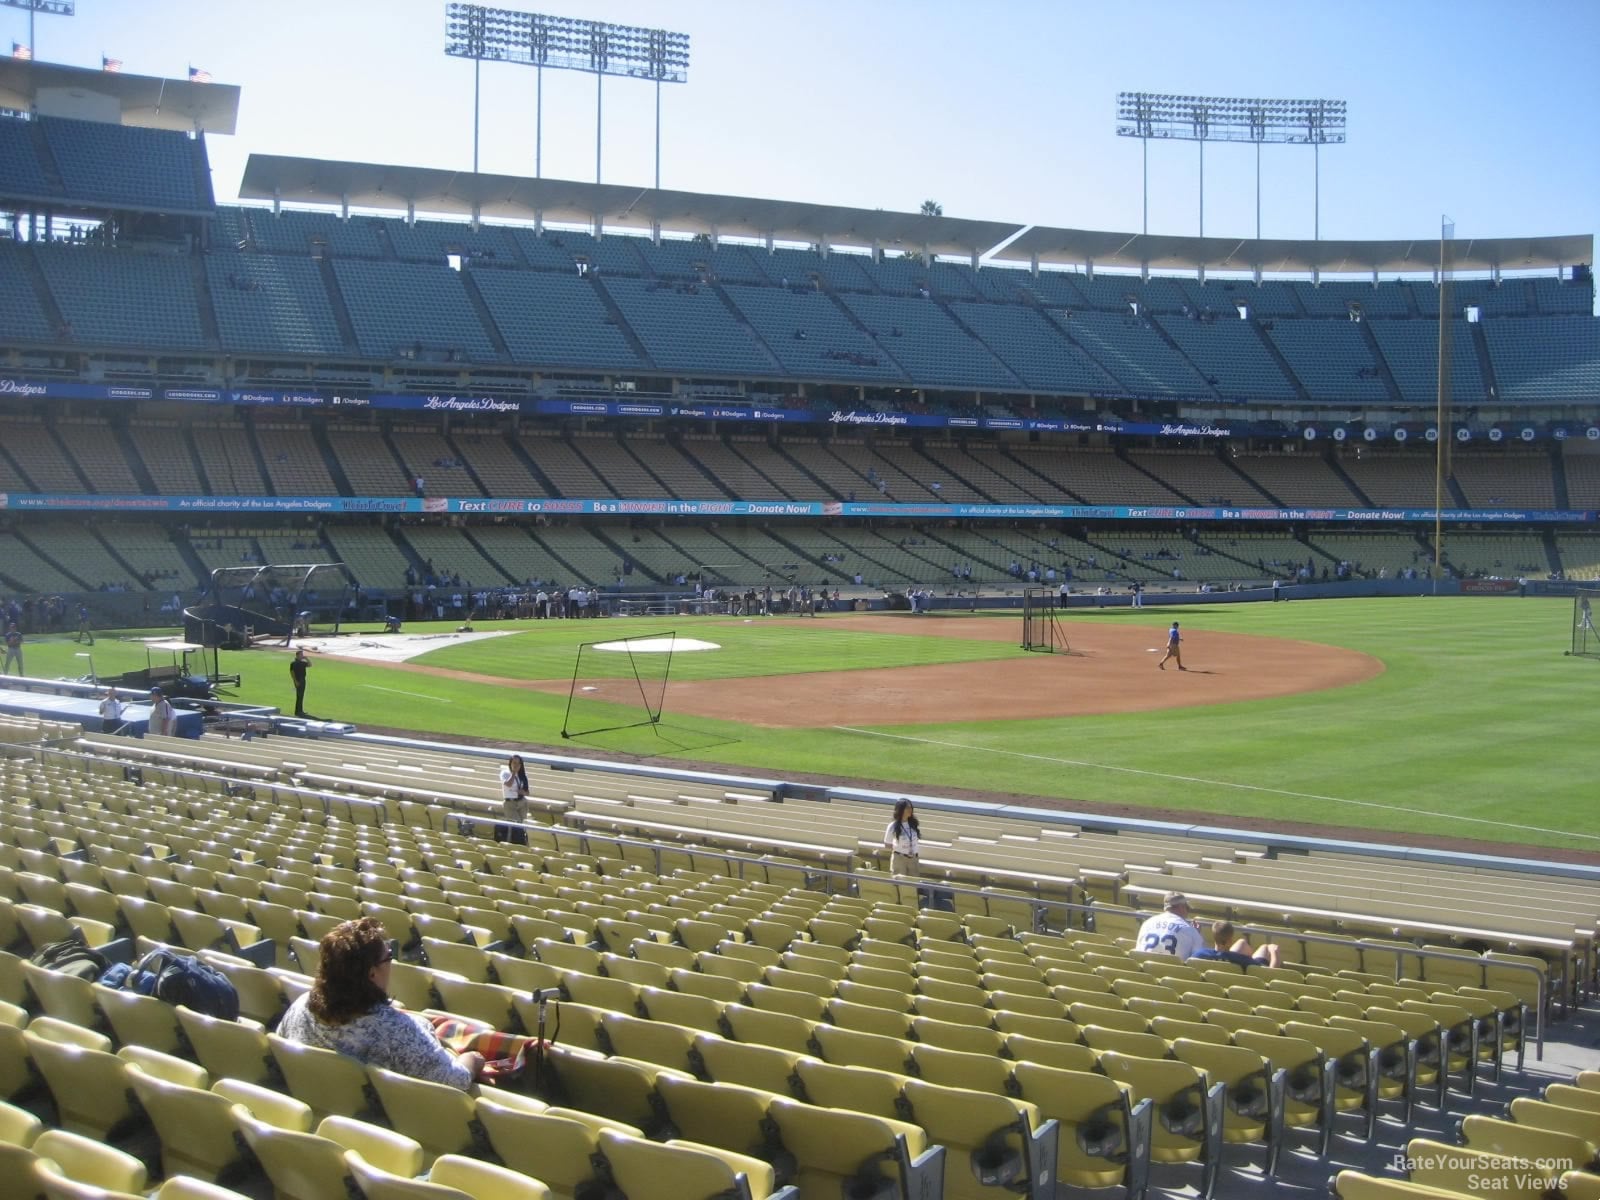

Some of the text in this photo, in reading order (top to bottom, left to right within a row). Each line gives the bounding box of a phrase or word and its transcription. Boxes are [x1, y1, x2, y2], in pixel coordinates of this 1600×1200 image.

[0, 380, 47, 396] Dodgers
[242, 394, 274, 402] @Dodgers
[292, 396, 323, 404] @Dodgers
[424, 396, 520, 411] Los Angeles Dodgers
[828, 411, 907, 424] Los Angeles Dodgers
[1160, 424, 1230, 437] Los Angeles Dodgers
[192, 499, 215, 507] official
[217, 500, 240, 508] charity
[275, 500, 302, 509] Angeles
[304, 500, 331, 510] Dodgers
[458, 500, 486, 511] Text
[527, 501, 541, 511] to
[593, 502, 608, 511] Be
[667, 503, 679, 512] in
[680, 503, 697, 512] the
[748, 504, 786, 513] Donate
[786, 504, 811, 513] Now!
[1128, 508, 1147, 517] Text
[1222, 509, 1233, 518] Be
[1280, 510, 1288, 518] in
[1290, 510, 1304, 518] the
[1347, 511, 1380, 519] Donate
[1381, 511, 1405, 519] Now!
